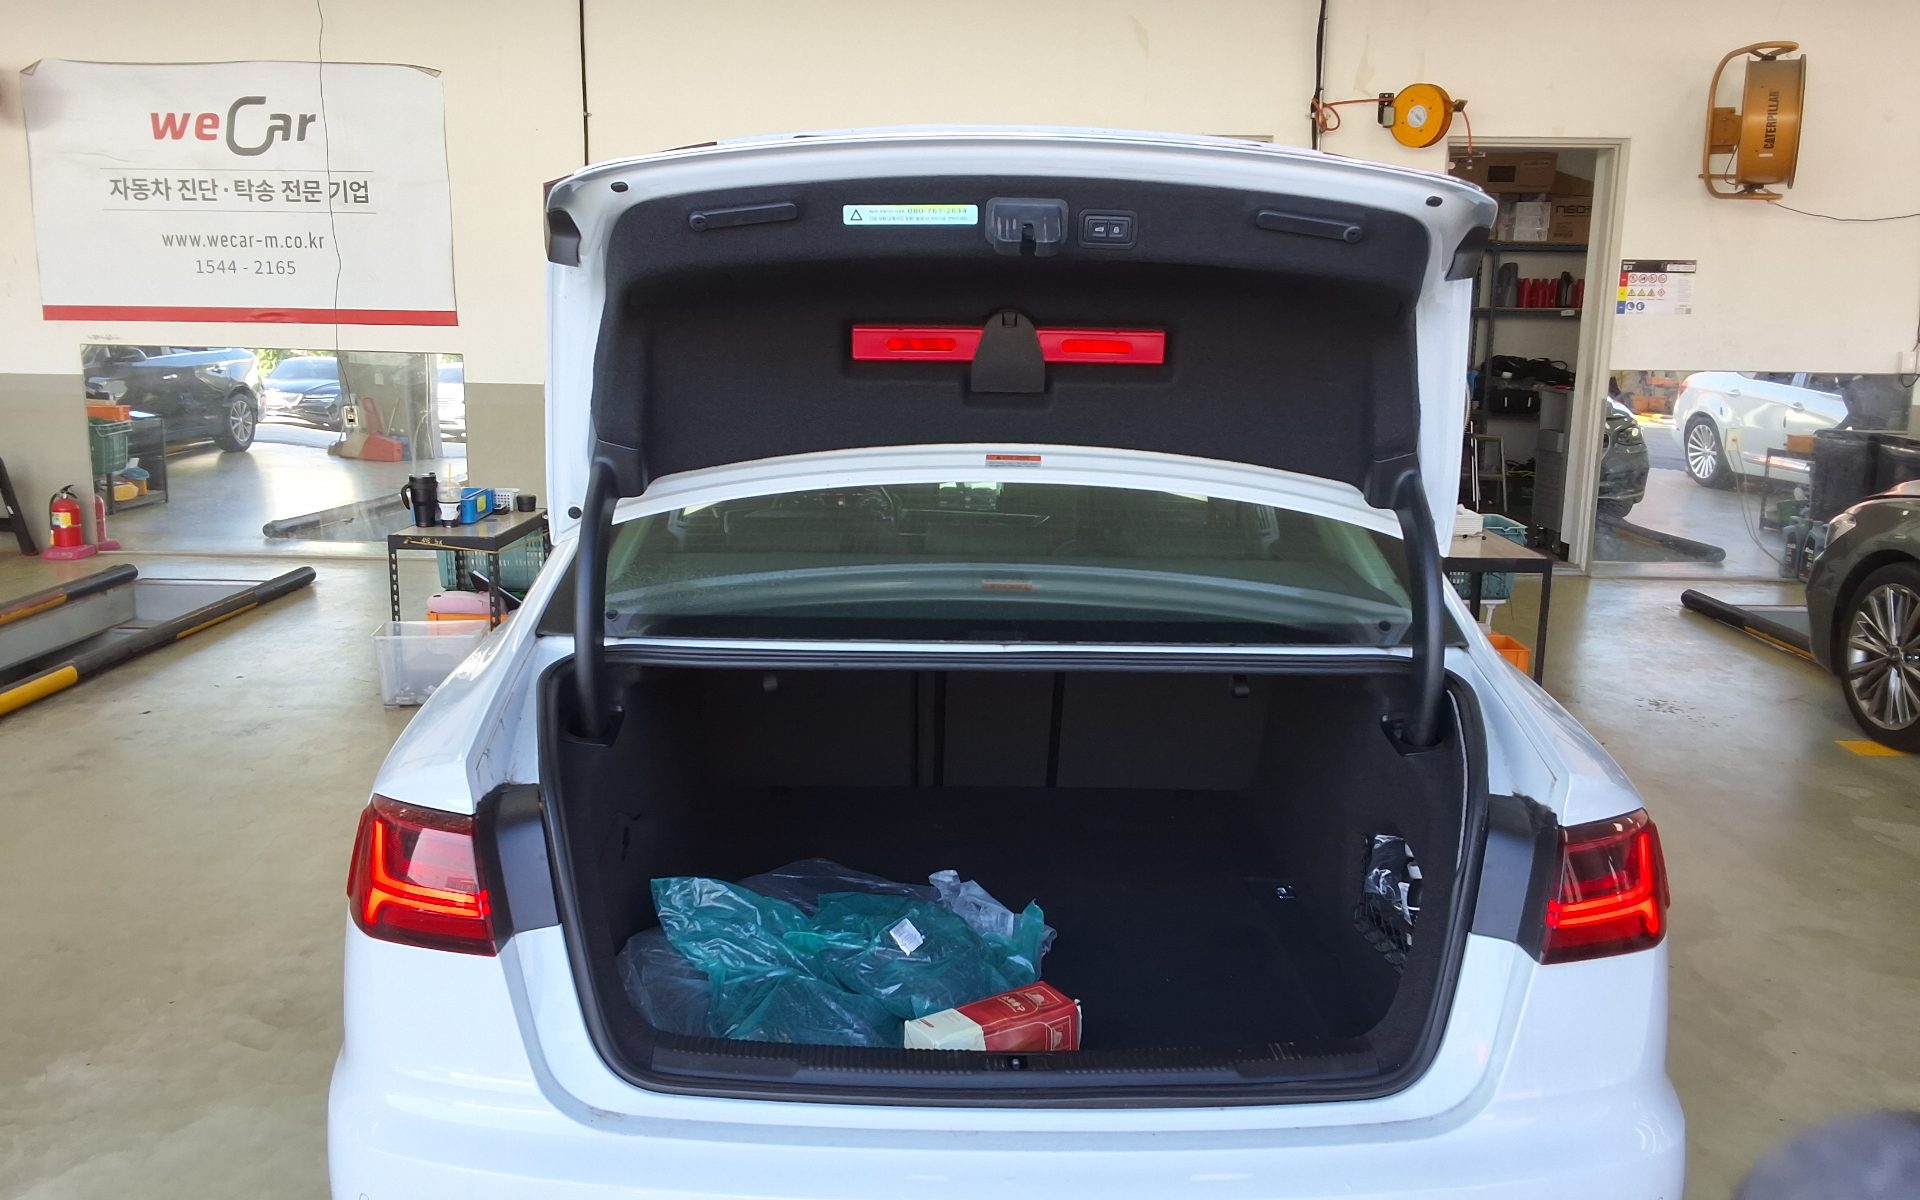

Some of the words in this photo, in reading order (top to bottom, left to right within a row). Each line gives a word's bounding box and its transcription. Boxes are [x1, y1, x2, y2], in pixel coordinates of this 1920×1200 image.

[1764, 90, 1780, 150] CATERPILLAR
[109, 178, 172, 202] 자동차
[281, 180, 323, 204] 전문
[329, 180, 370, 204] 기업
[162, 232, 325, 249] www.wecar-m.co.kr
